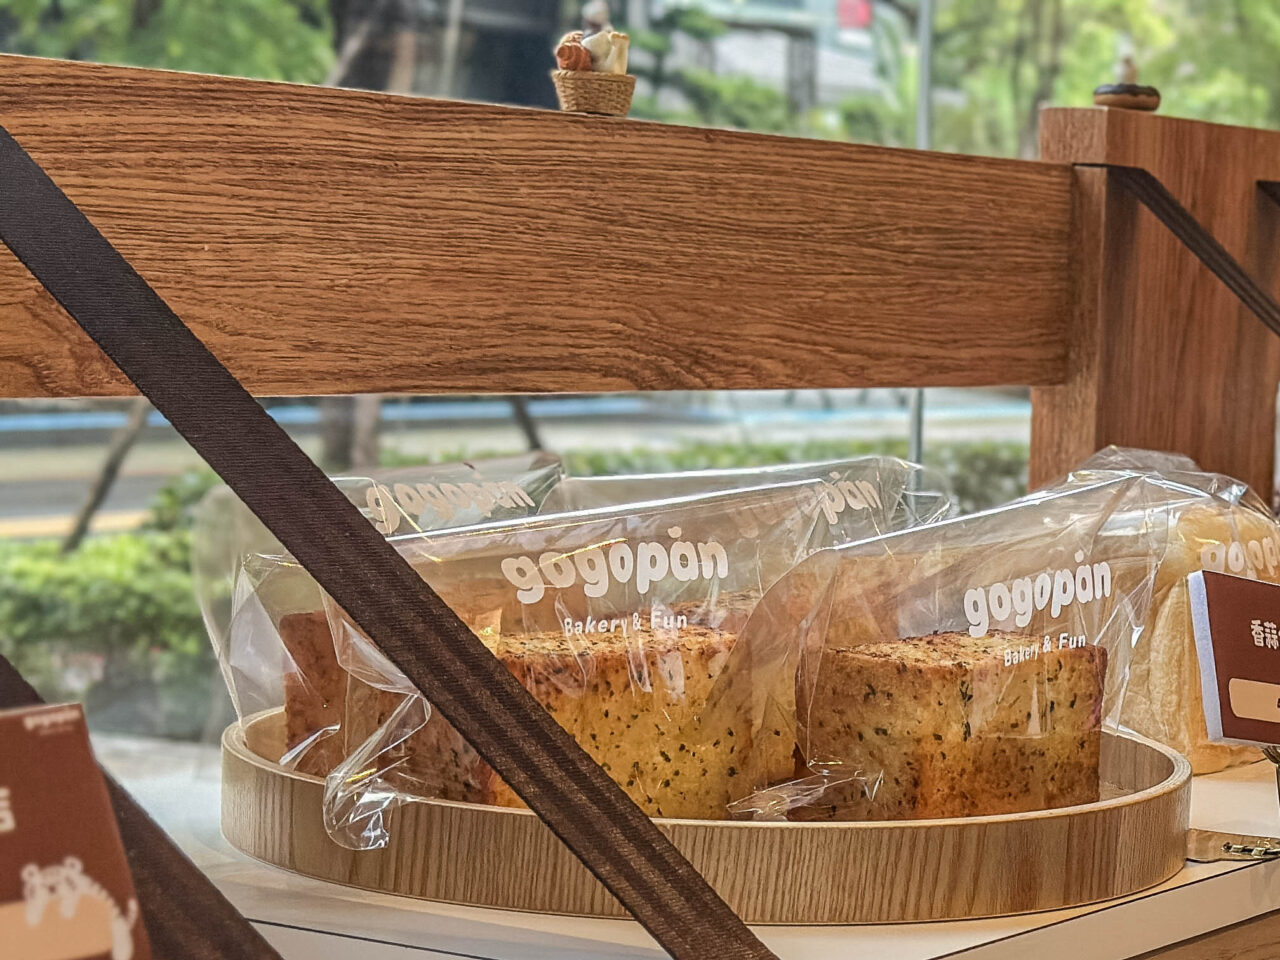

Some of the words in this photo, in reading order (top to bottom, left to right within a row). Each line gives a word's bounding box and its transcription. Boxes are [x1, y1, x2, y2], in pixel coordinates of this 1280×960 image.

[564, 616, 628, 637] Bakery
[632, 612, 642, 630] &
[650, 611, 688, 629] Fun
[1004, 641, 1039, 667] Bakery
[1042, 635, 1052, 653] &
[1058, 632, 1086, 650] Fun
